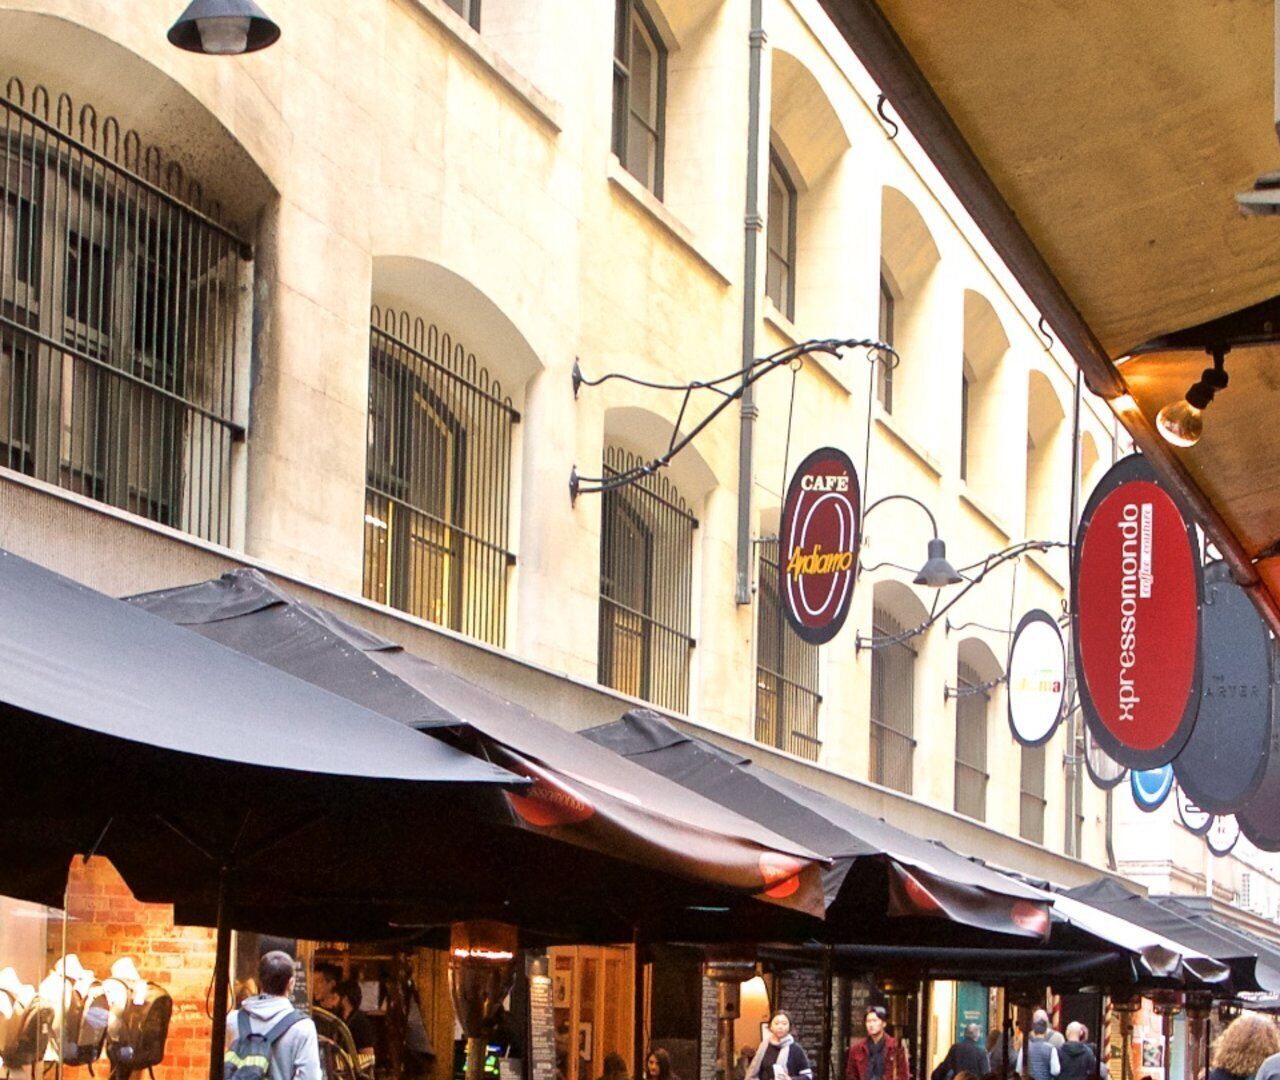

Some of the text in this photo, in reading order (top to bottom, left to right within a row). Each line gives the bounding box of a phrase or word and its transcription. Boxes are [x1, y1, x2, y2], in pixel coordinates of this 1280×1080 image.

[800, 470, 850, 492] CAFÉ
[786, 544, 853, 582] Andiamo
[1140, 509, 1154, 595] coffee couture
[1117, 503, 1140, 721] xpressomondo
[1205, 685, 1259, 698] ARTER
